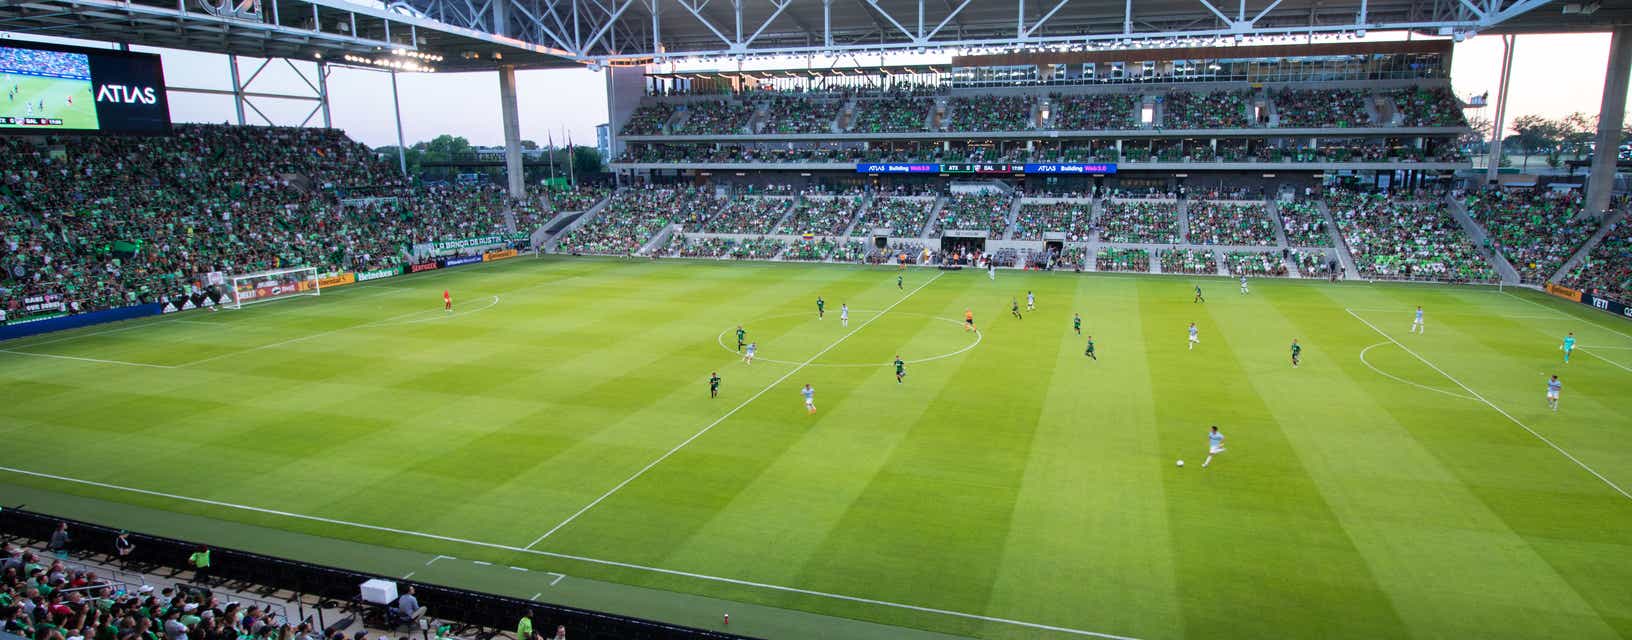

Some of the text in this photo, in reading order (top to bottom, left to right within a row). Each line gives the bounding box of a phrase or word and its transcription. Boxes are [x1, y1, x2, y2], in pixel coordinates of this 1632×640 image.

[97, 84, 156, 104] ATLAS
[888, 165, 909, 173] Building
[1060, 165, 1083, 173] Building
[357, 270, 394, 282] Heineken
[1592, 297, 1609, 310] YETI
